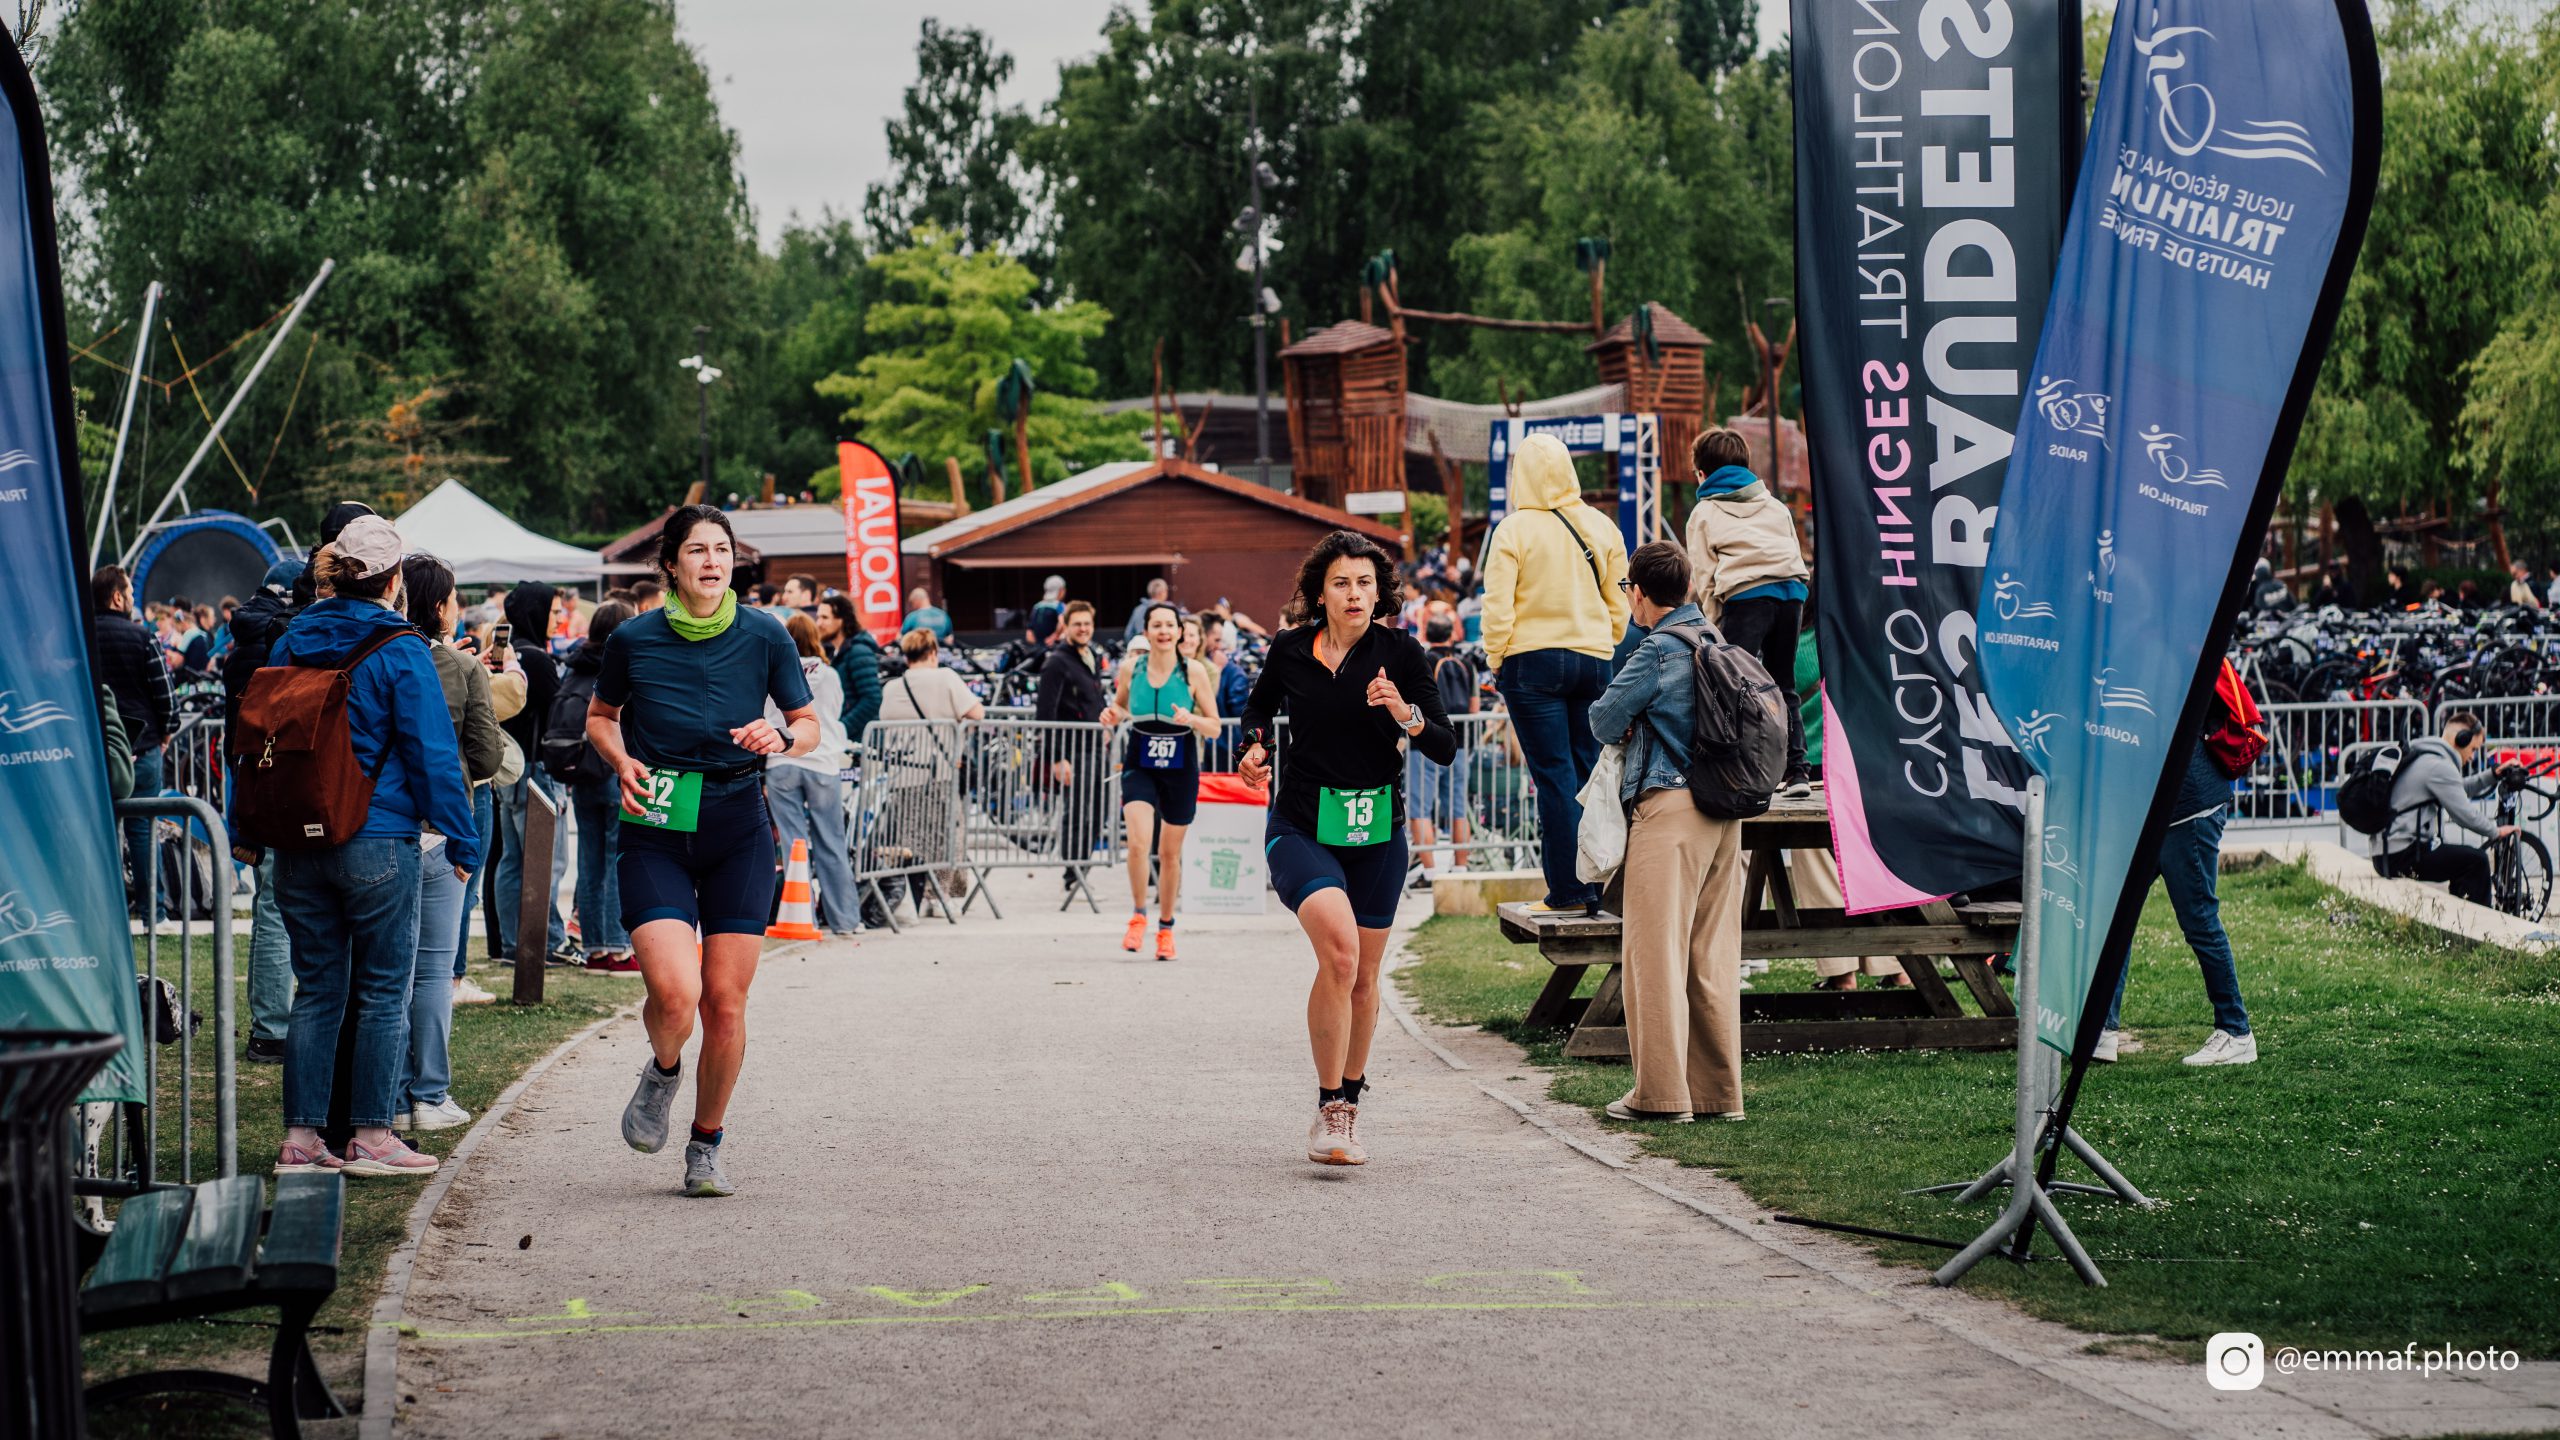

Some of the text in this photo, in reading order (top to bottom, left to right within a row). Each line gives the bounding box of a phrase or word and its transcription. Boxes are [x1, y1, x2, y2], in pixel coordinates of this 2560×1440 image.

[1147, 740, 1177, 759] 267
[645, 774, 675, 808] 12
[1343, 797, 1374, 827] 13
